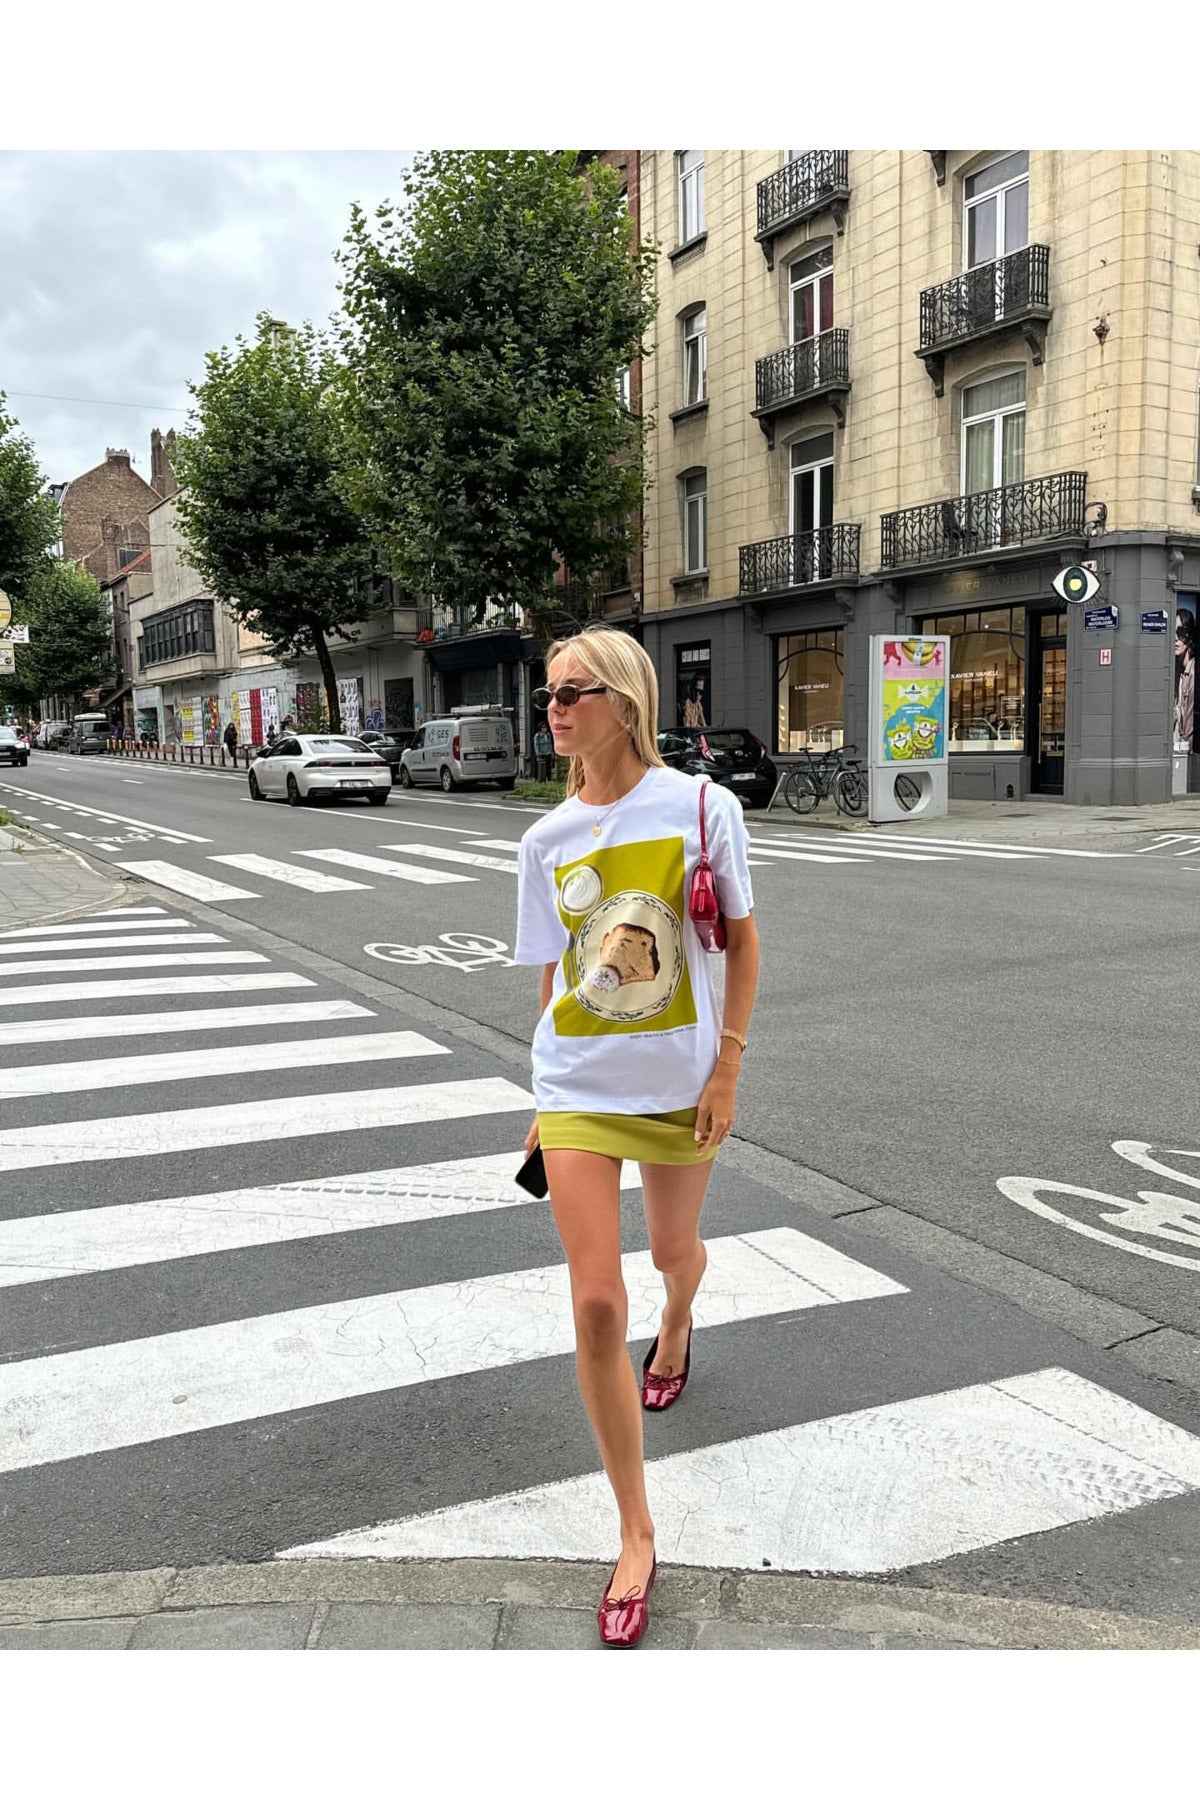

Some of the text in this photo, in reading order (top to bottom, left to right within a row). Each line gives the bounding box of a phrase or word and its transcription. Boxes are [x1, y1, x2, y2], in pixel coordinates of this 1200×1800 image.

[1102, 651, 1110, 663] H
[951, 672, 974, 680] XAVIER
[436, 729, 450, 739] GES
